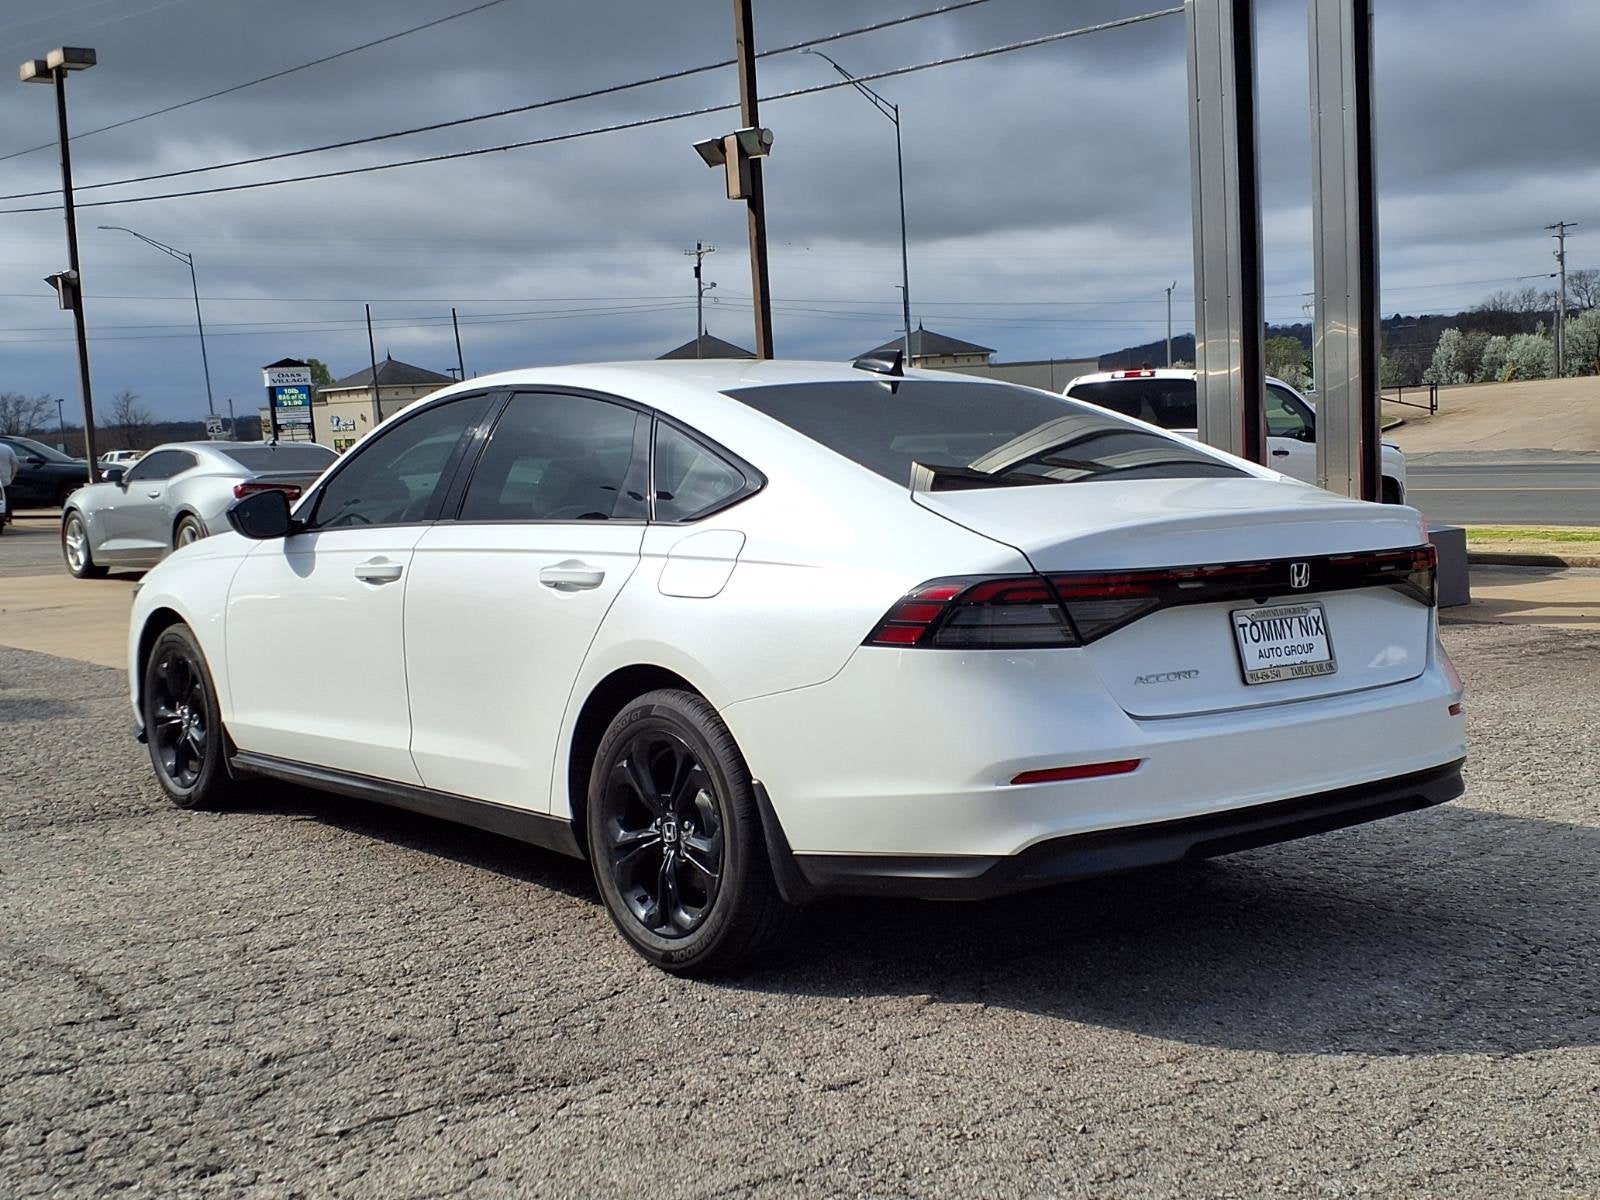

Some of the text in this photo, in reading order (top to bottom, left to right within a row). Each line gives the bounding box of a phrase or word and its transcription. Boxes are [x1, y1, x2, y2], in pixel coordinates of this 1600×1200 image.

[208, 425, 222, 434] 45
[1239, 615, 1324, 644] TOMMY NIX
[1258, 643, 1314, 660] AUTO GROUP
[1134, 669, 1200, 685] ACCORD
